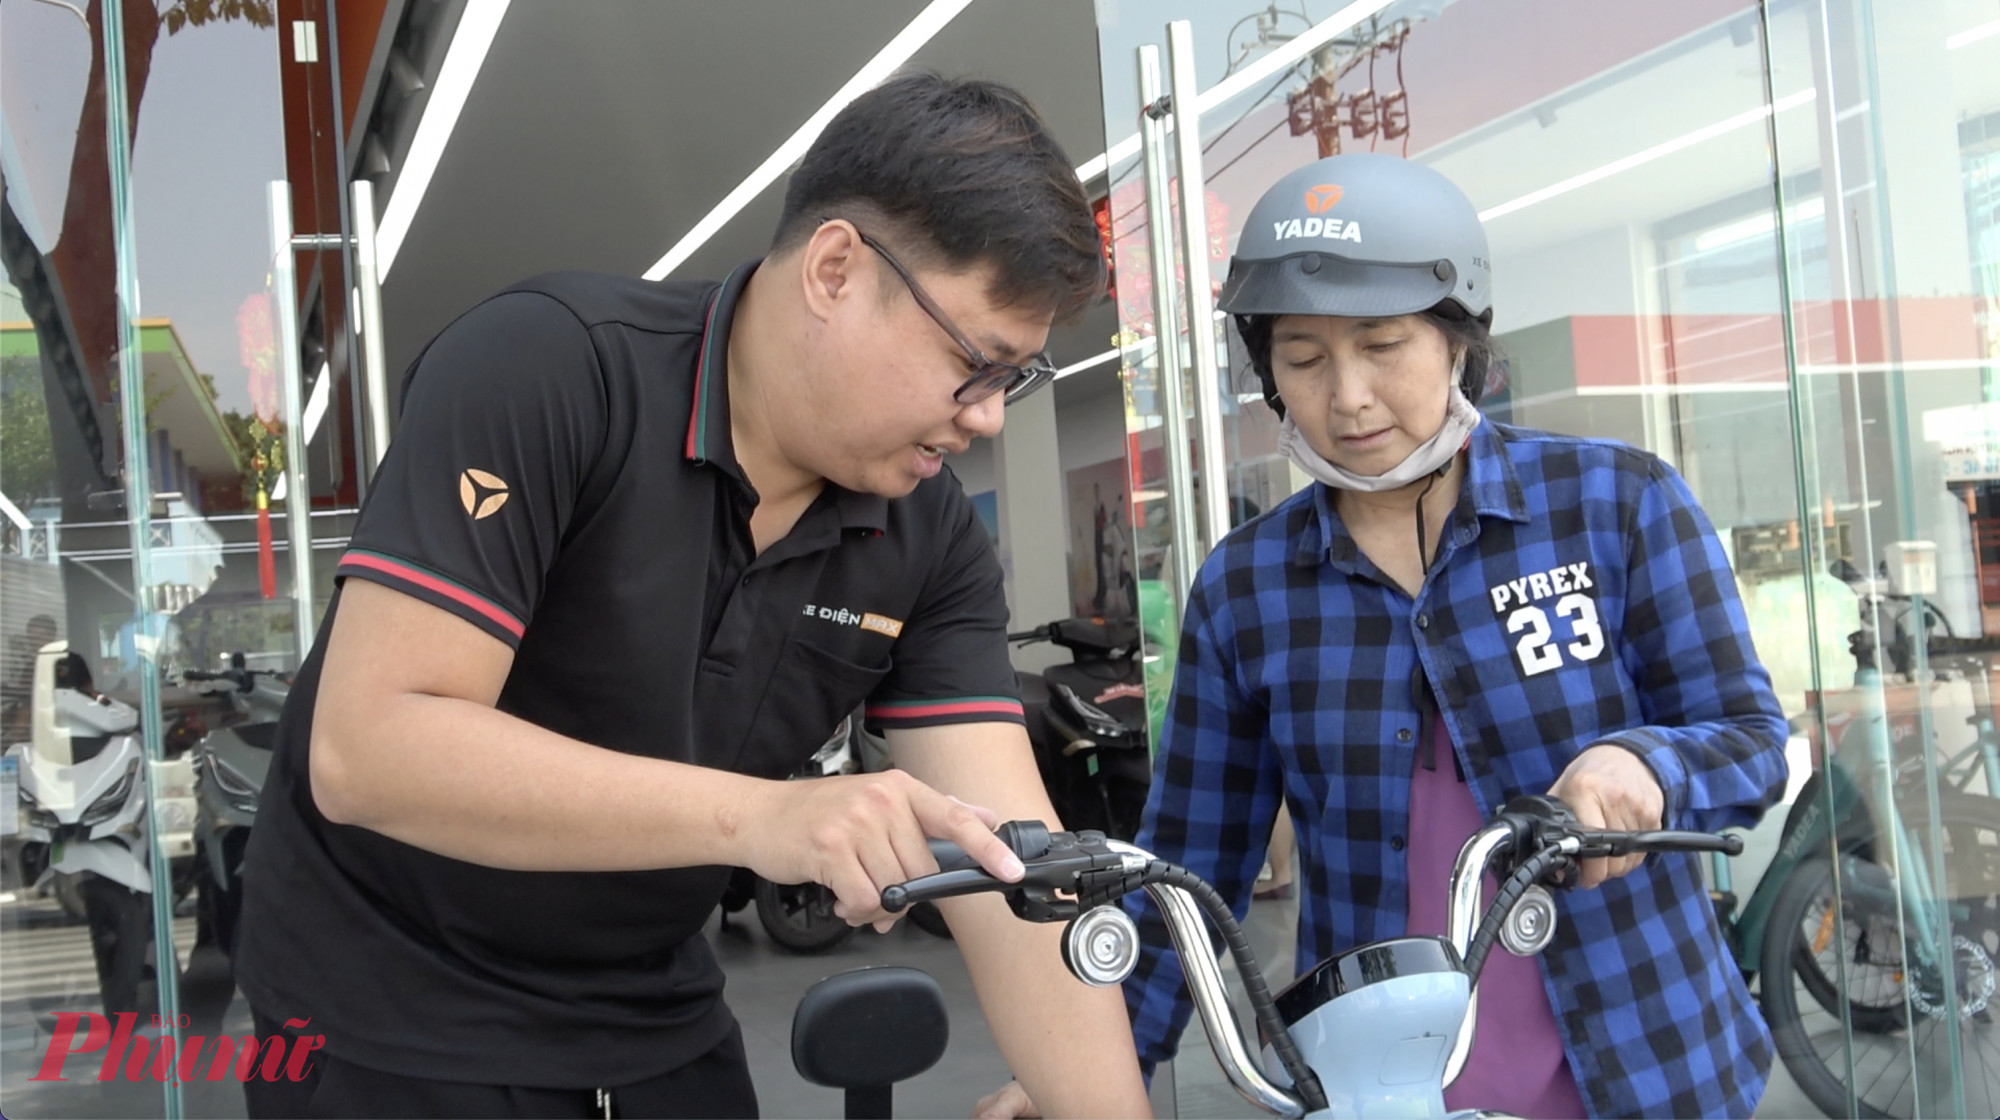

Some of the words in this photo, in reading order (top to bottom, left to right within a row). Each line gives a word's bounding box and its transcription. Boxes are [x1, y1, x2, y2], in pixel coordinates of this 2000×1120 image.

[1273, 217, 1362, 243] YADEA
[1490, 562, 1593, 613] PYREX
[819, 607, 861, 626] ĐIỆN
[1507, 593, 1605, 677] 23
[1784, 804, 1821, 860] YADEA
